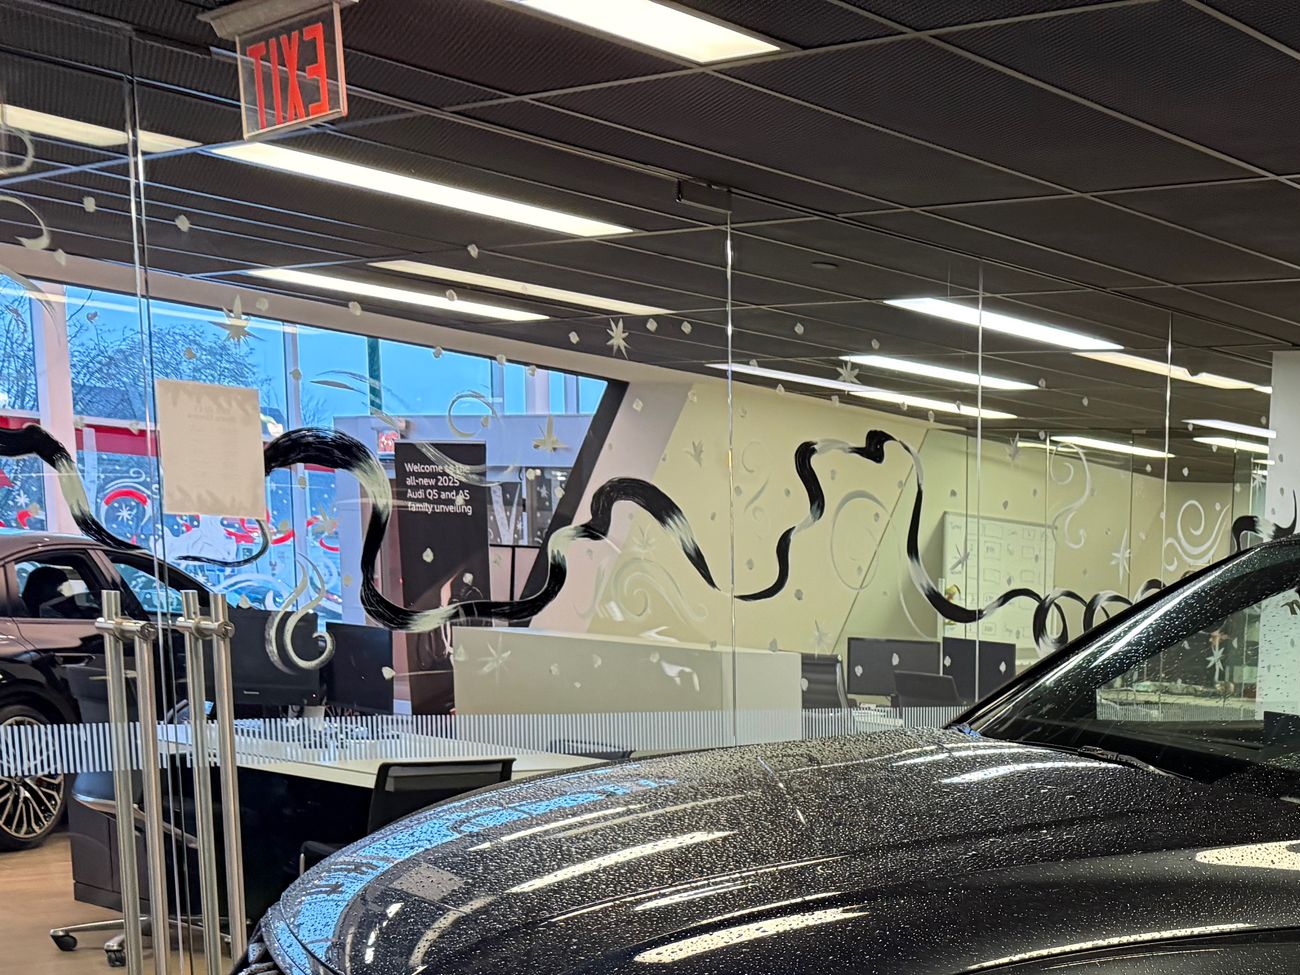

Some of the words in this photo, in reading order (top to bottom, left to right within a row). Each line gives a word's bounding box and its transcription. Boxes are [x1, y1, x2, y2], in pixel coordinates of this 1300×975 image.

[404, 462, 444, 473] Welcome
[406, 475, 436, 486] all-new
[437, 476, 460, 486] 2025
[407, 489, 425, 499] Audi
[426, 489, 439, 500] Q5
[440, 490, 456, 499] and
[458, 490, 470, 500] A5
[408, 502, 433, 514] family
[434, 504, 472, 516] unveiling
